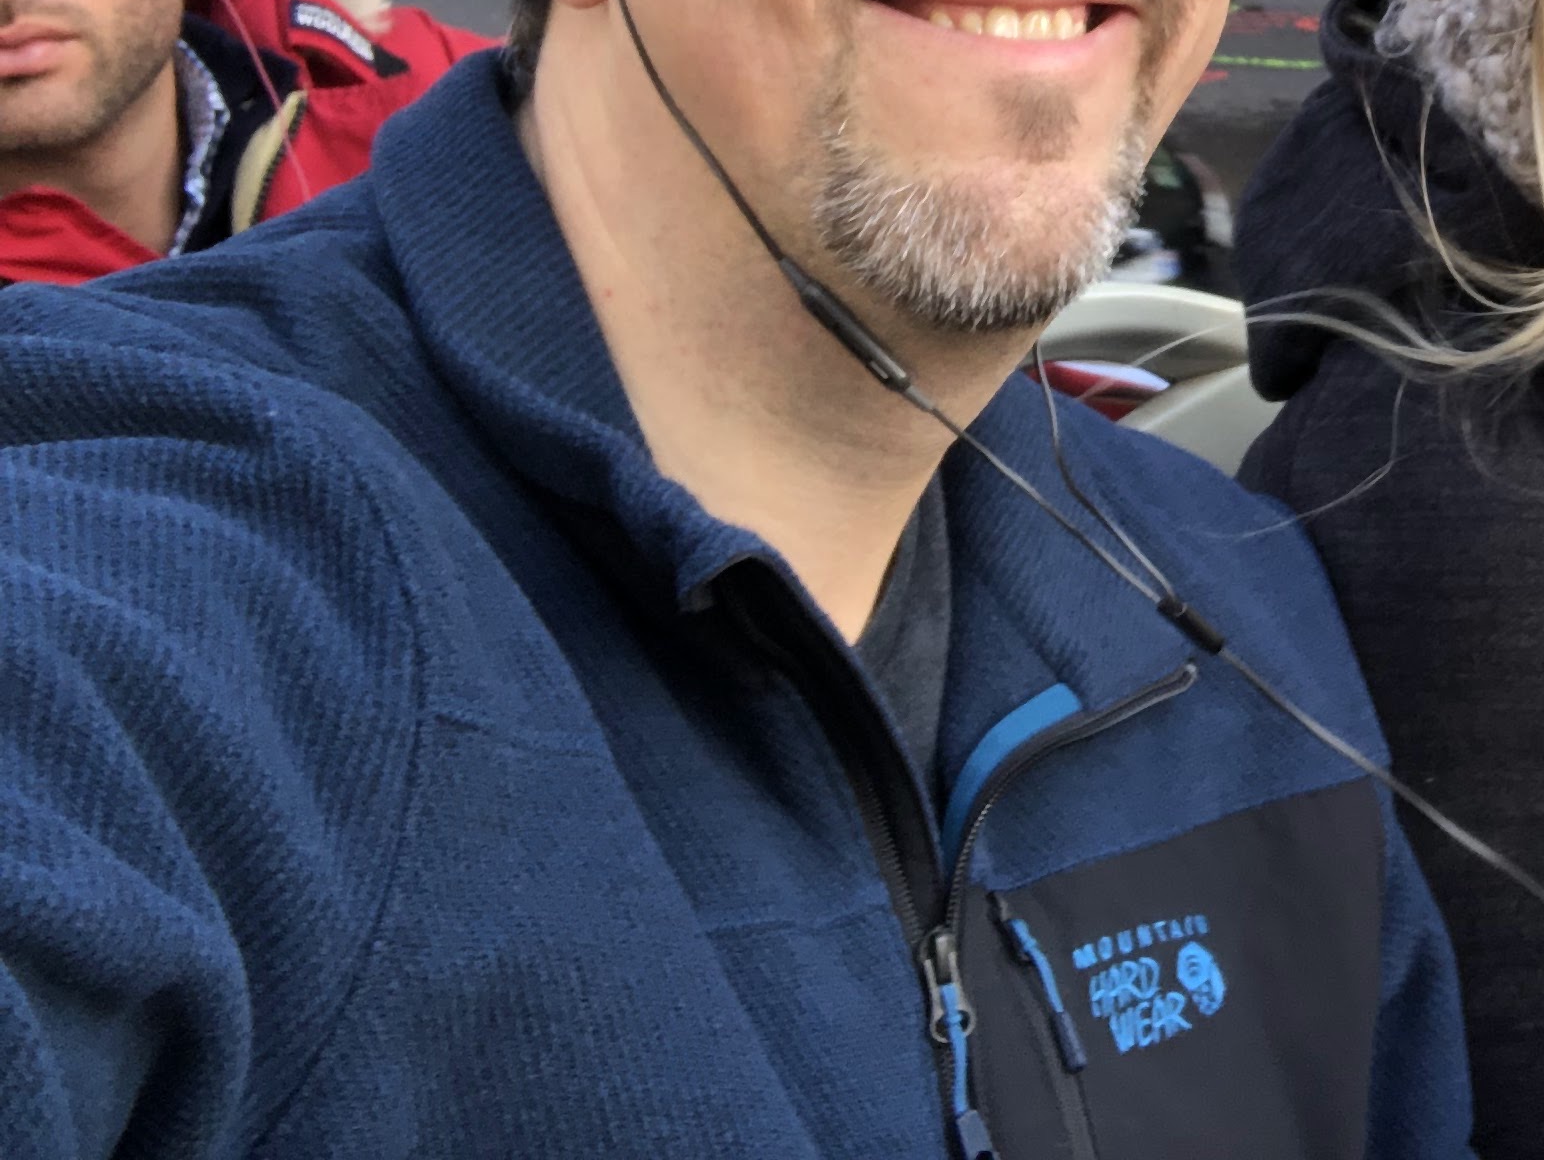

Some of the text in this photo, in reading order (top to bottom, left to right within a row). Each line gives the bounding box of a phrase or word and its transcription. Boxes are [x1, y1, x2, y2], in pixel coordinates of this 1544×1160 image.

[1072, 914, 1208, 970] MOUNTAIN
[1089, 956, 1161, 1018] HARD
[1109, 991, 1193, 1055] WEAR
